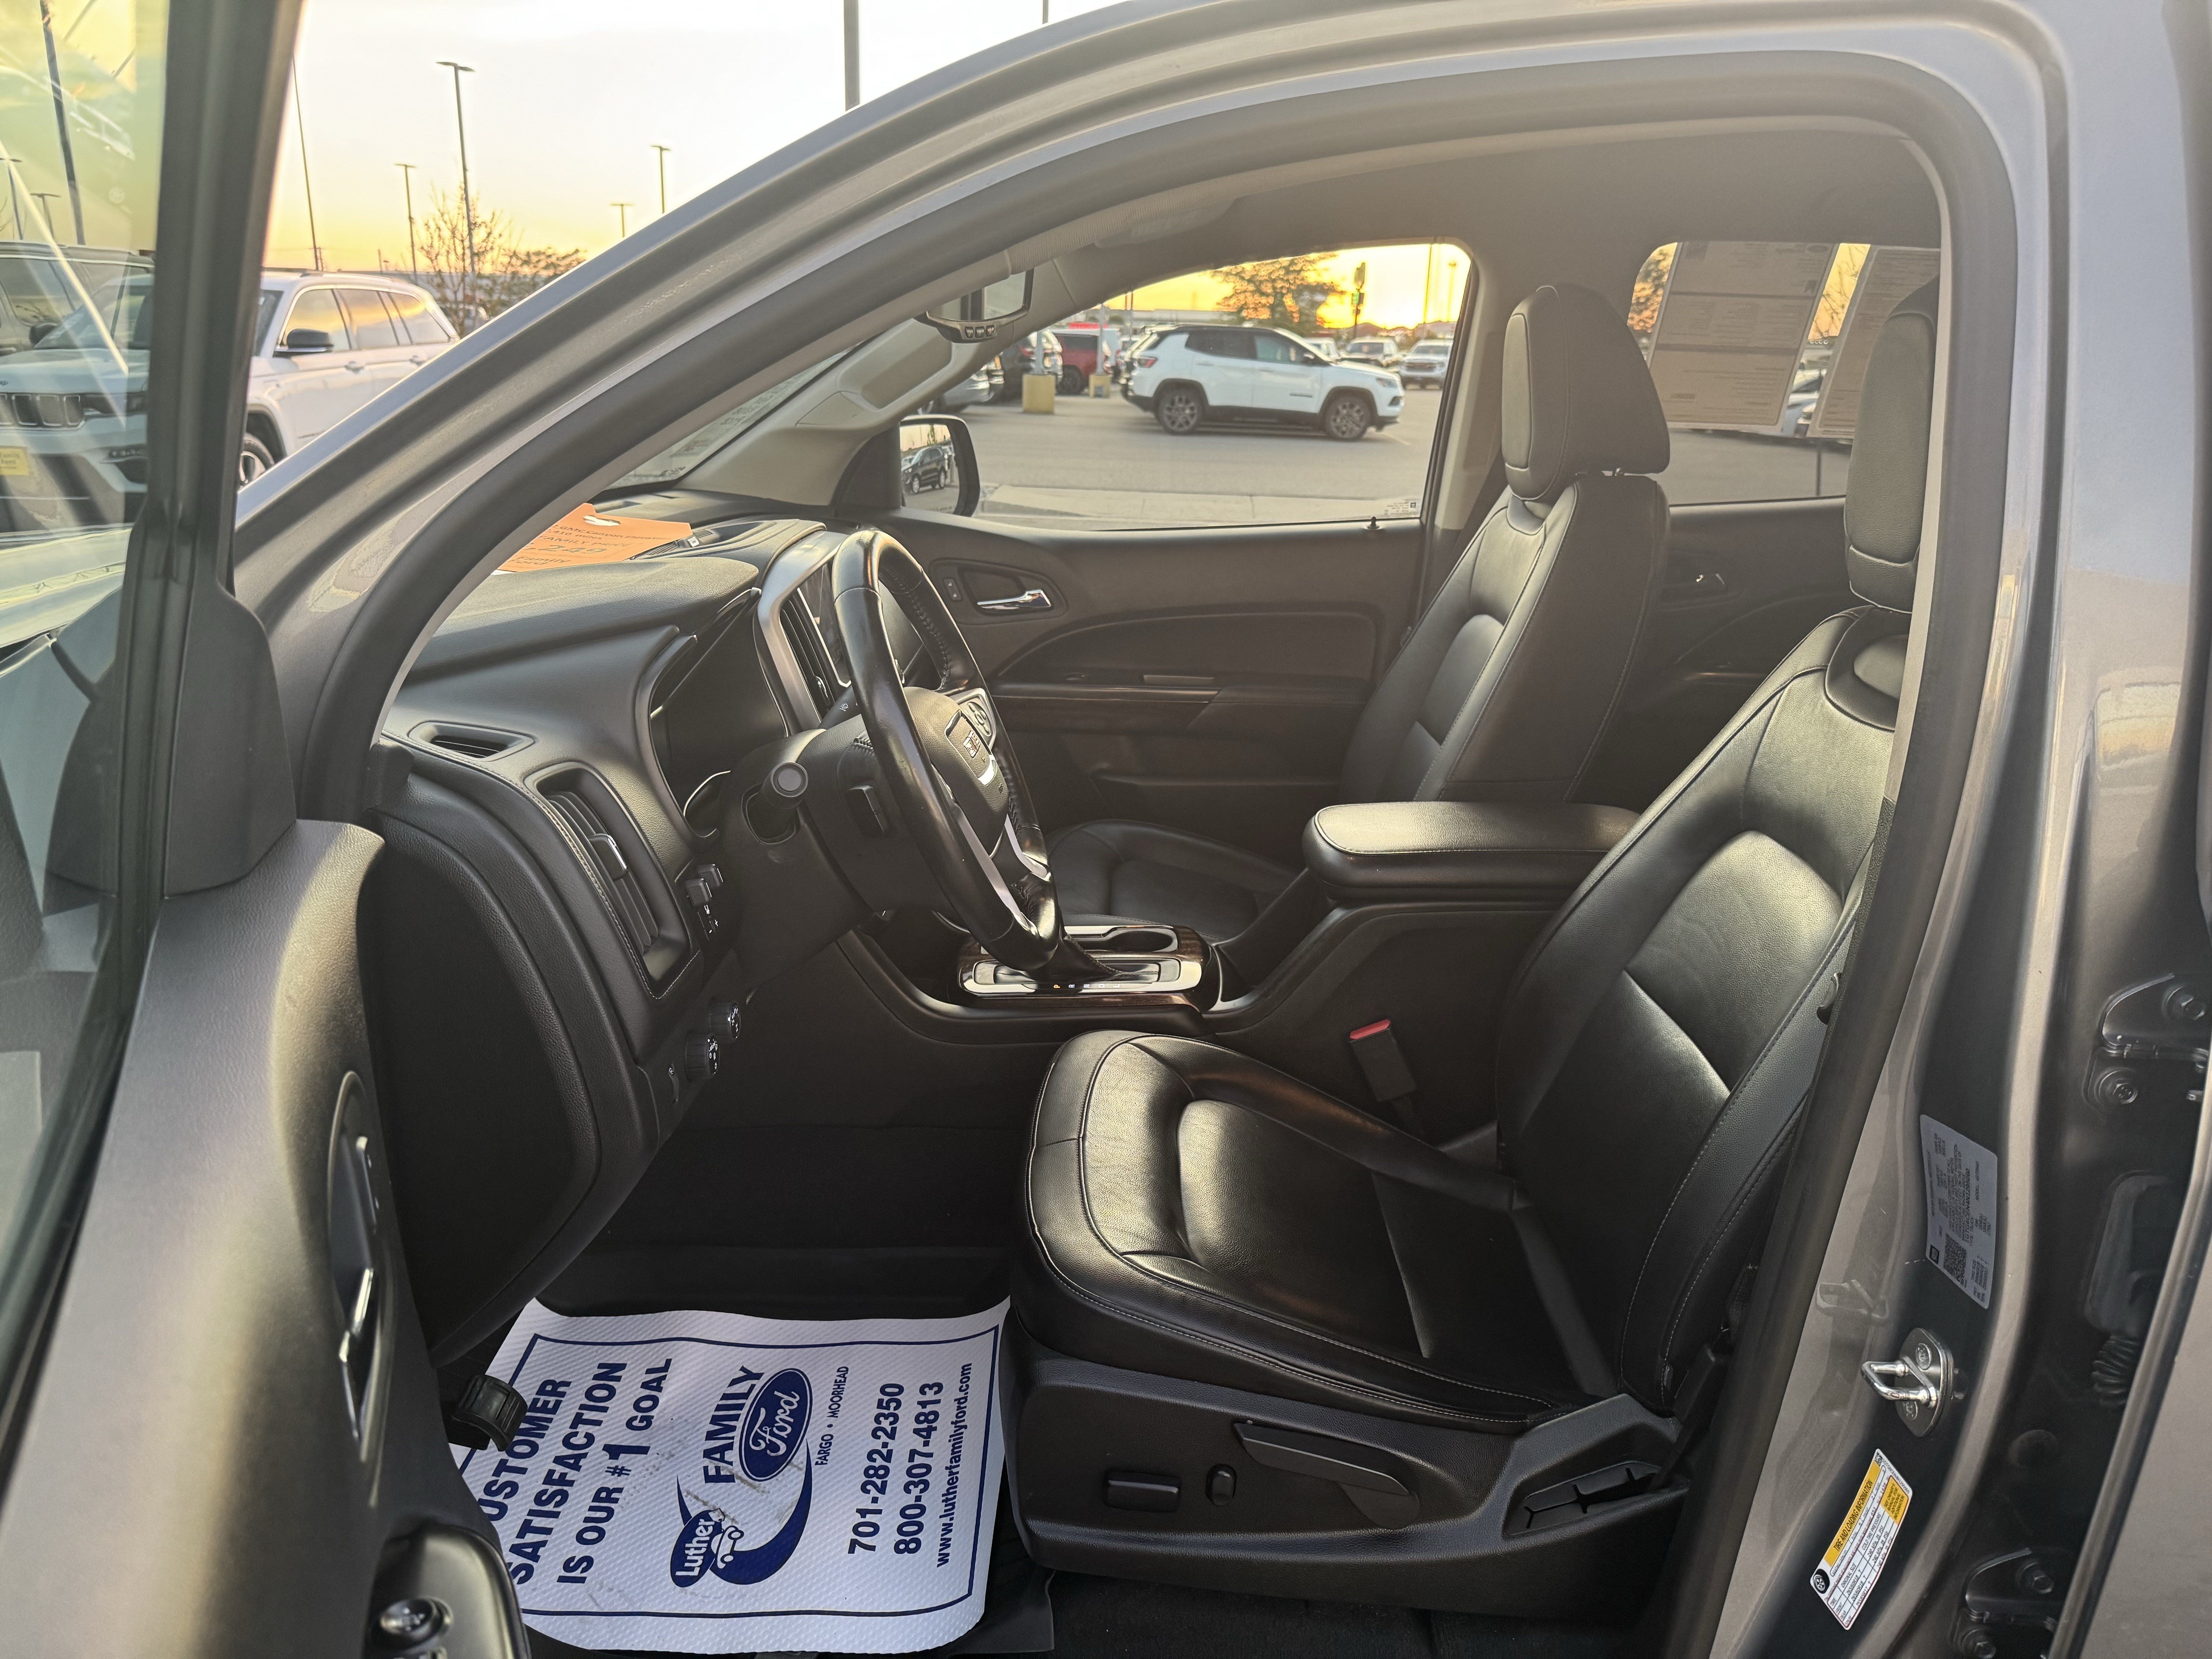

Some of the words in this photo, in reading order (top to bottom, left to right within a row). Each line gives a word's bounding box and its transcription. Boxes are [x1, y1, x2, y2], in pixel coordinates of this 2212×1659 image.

[625, 1358, 672, 1431] GOAL
[703, 1365, 764, 1483] FAMILY
[749, 1390, 800, 1456] Ford
[815, 1433, 834, 1465] FARGO
[827, 1365, 849, 1418] MOORHEAD
[477, 1379, 572, 1521] USTOMER
[507, 1362, 627, 1584] SATISFACTION
[602, 1443, 651, 1476] #1
[847, 1382, 904, 1554] 701-282-2350
[893, 1381, 943, 1554] 800-307-4813
[936, 1362, 972, 1568] www.lutherfamilyford.com
[575, 1486, 624, 1545] OUR
[675, 1518, 715, 1576] Luther
[1833, 1538, 1843, 1553] TIRE
[1839, 1528, 1848, 1542] AND
[1844, 1508, 1858, 1532] LOADING
[1855, 1478, 1873, 1512] INFORMATION
[556, 1555, 594, 1583] IS
